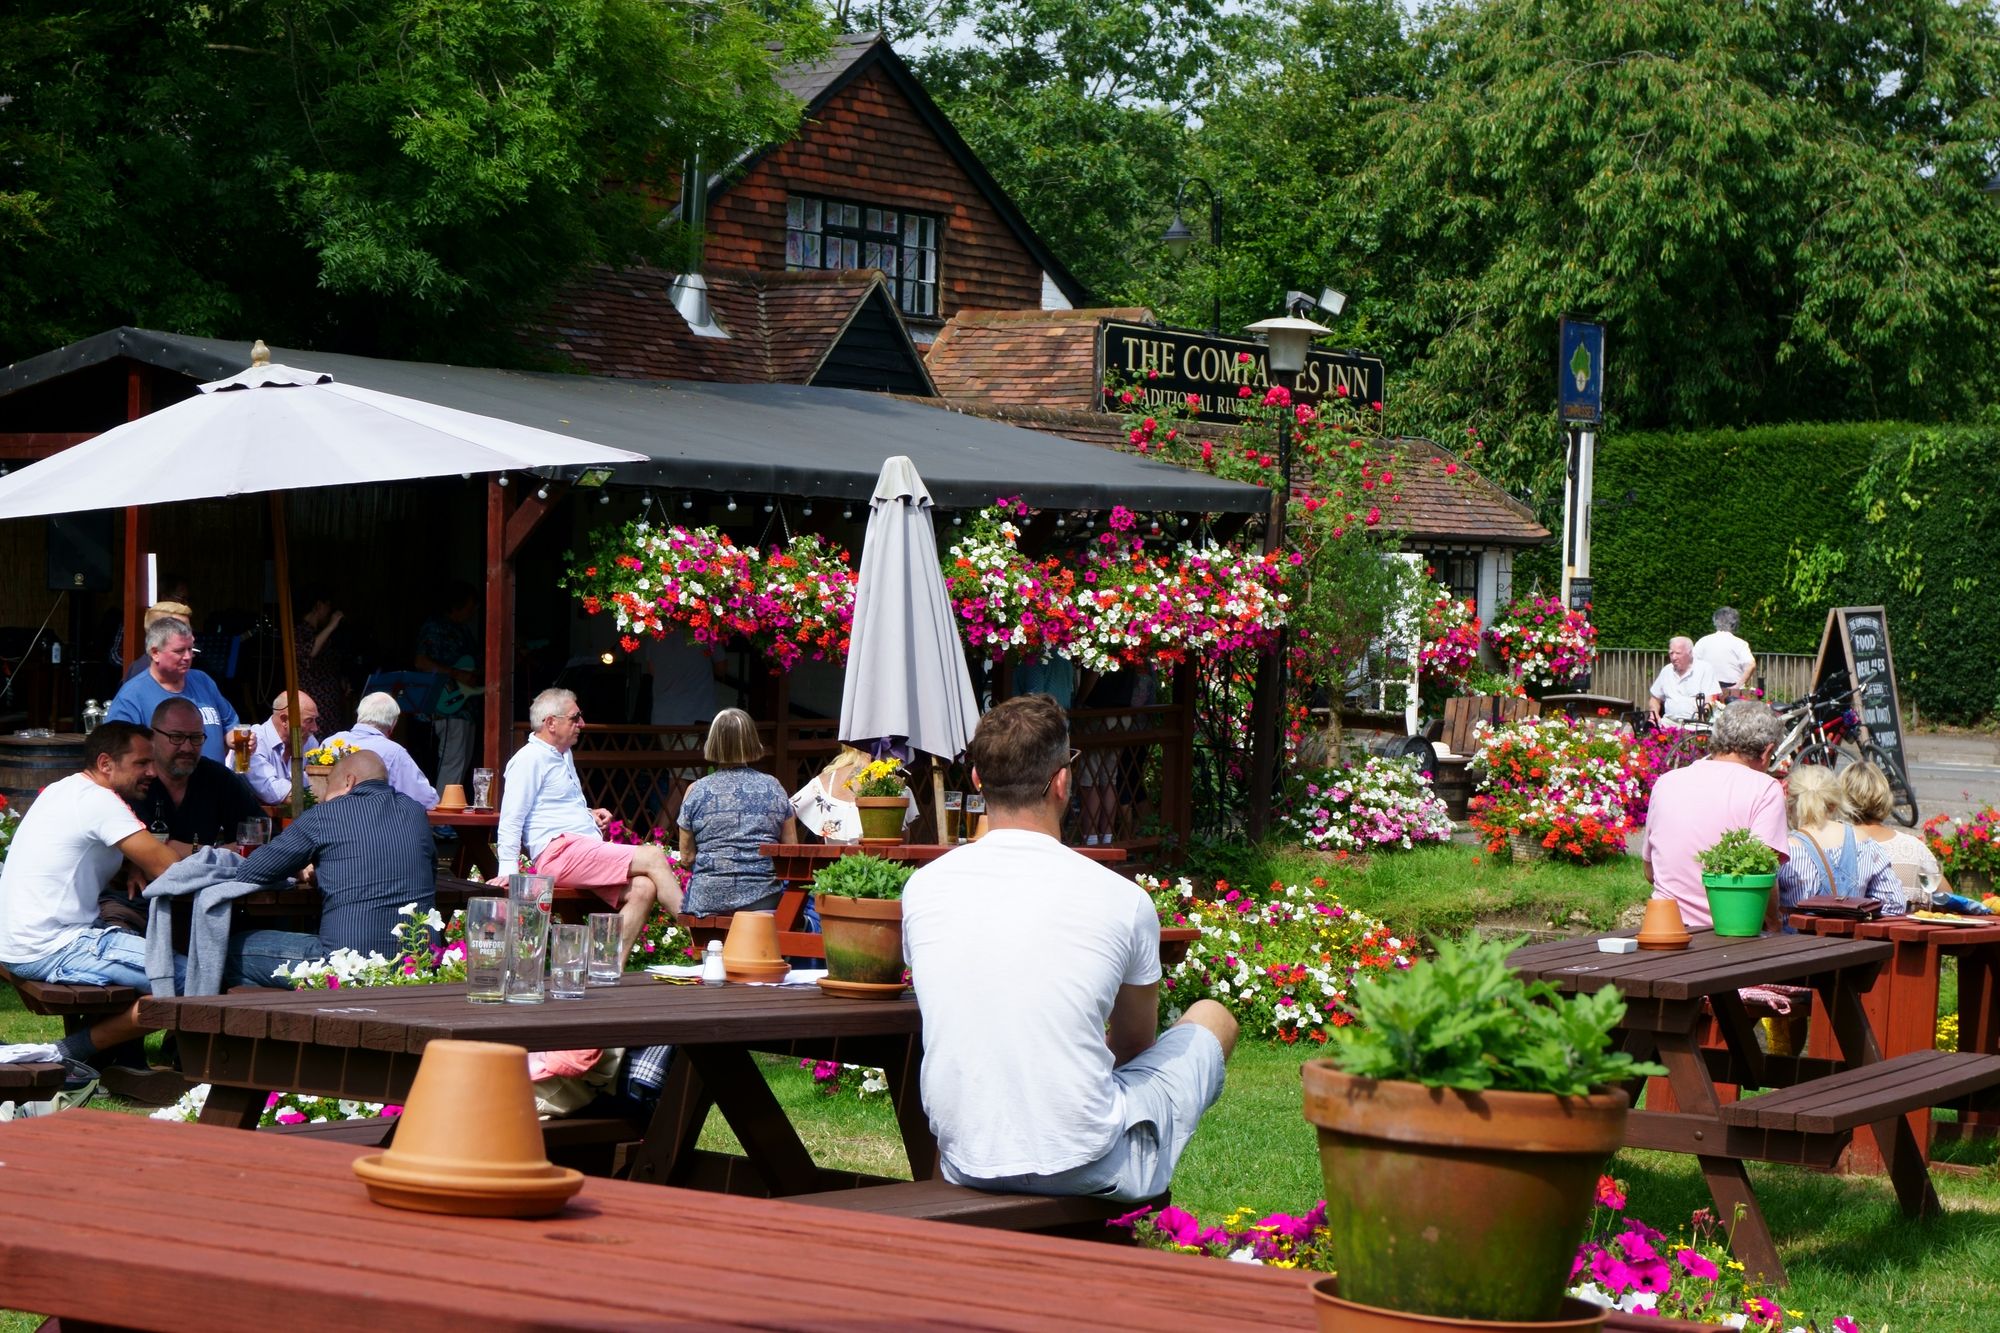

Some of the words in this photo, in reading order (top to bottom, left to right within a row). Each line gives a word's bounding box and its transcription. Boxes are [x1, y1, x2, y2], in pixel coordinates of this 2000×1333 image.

[1122, 336, 1176, 377] THE
[1183, 345, 1320, 394] COMPAES
[1327, 363, 1369, 399] INN
[1141, 387, 1225, 413] ADITIOAL
[1855, 634, 1876, 650] FOOD
